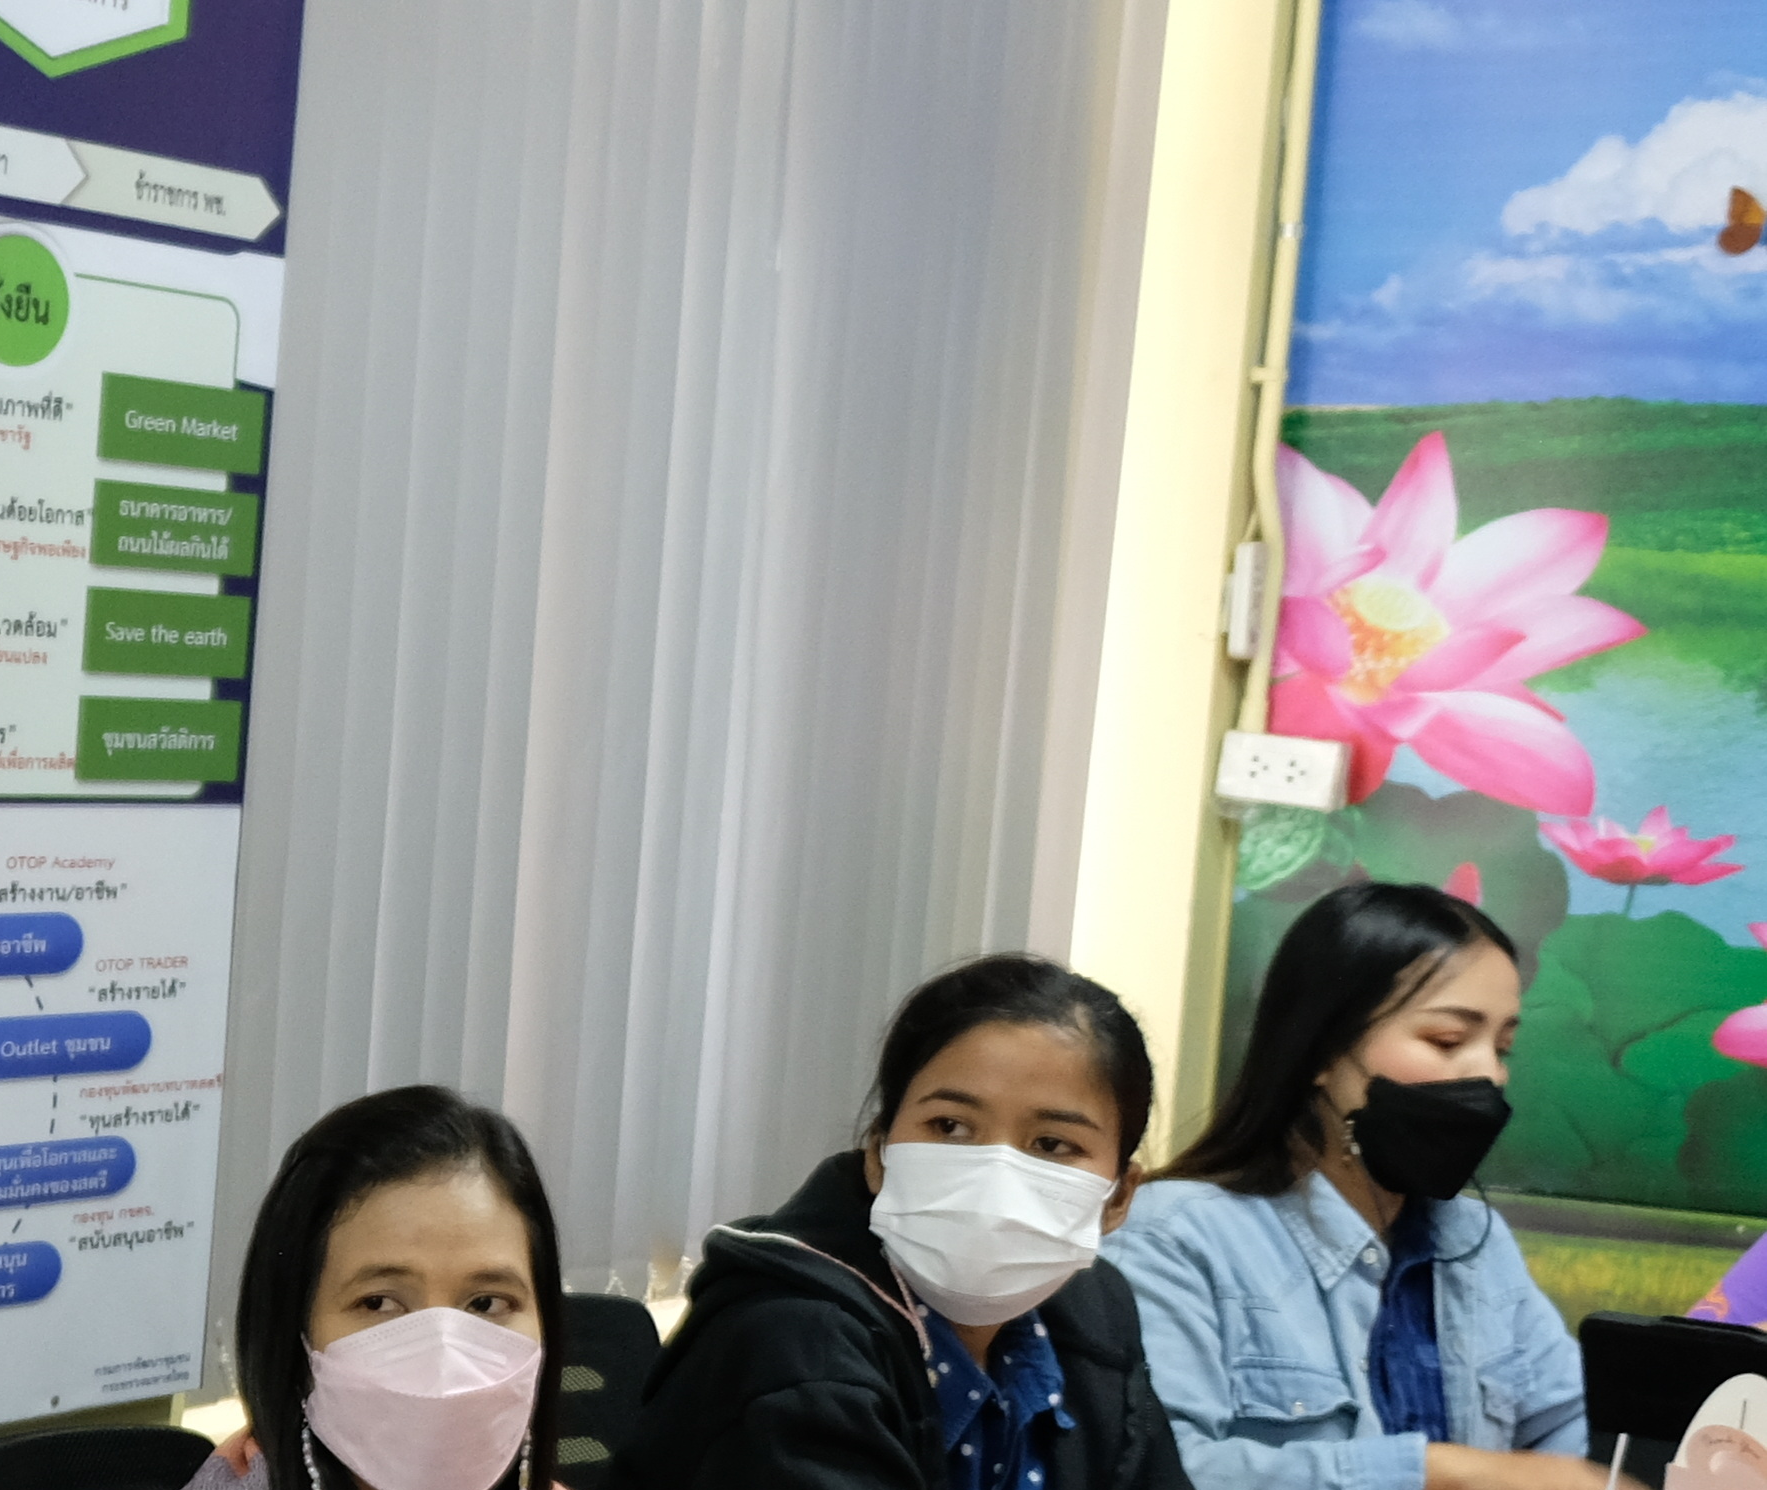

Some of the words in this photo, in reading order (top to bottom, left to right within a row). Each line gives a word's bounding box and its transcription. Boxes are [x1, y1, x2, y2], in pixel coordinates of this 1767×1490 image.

[125, 410, 176, 433] Green
[181, 417, 239, 442] Market
[105, 621, 146, 642] Save
[151, 624, 178, 643] the
[183, 627, 228, 647] earth
[6, 855, 47, 871] OTOP
[51, 855, 115, 872] Academy
[95, 957, 135, 973] OTOP
[139, 955, 189, 971] TRADER
[0, 1037, 57, 1058] Outlet
